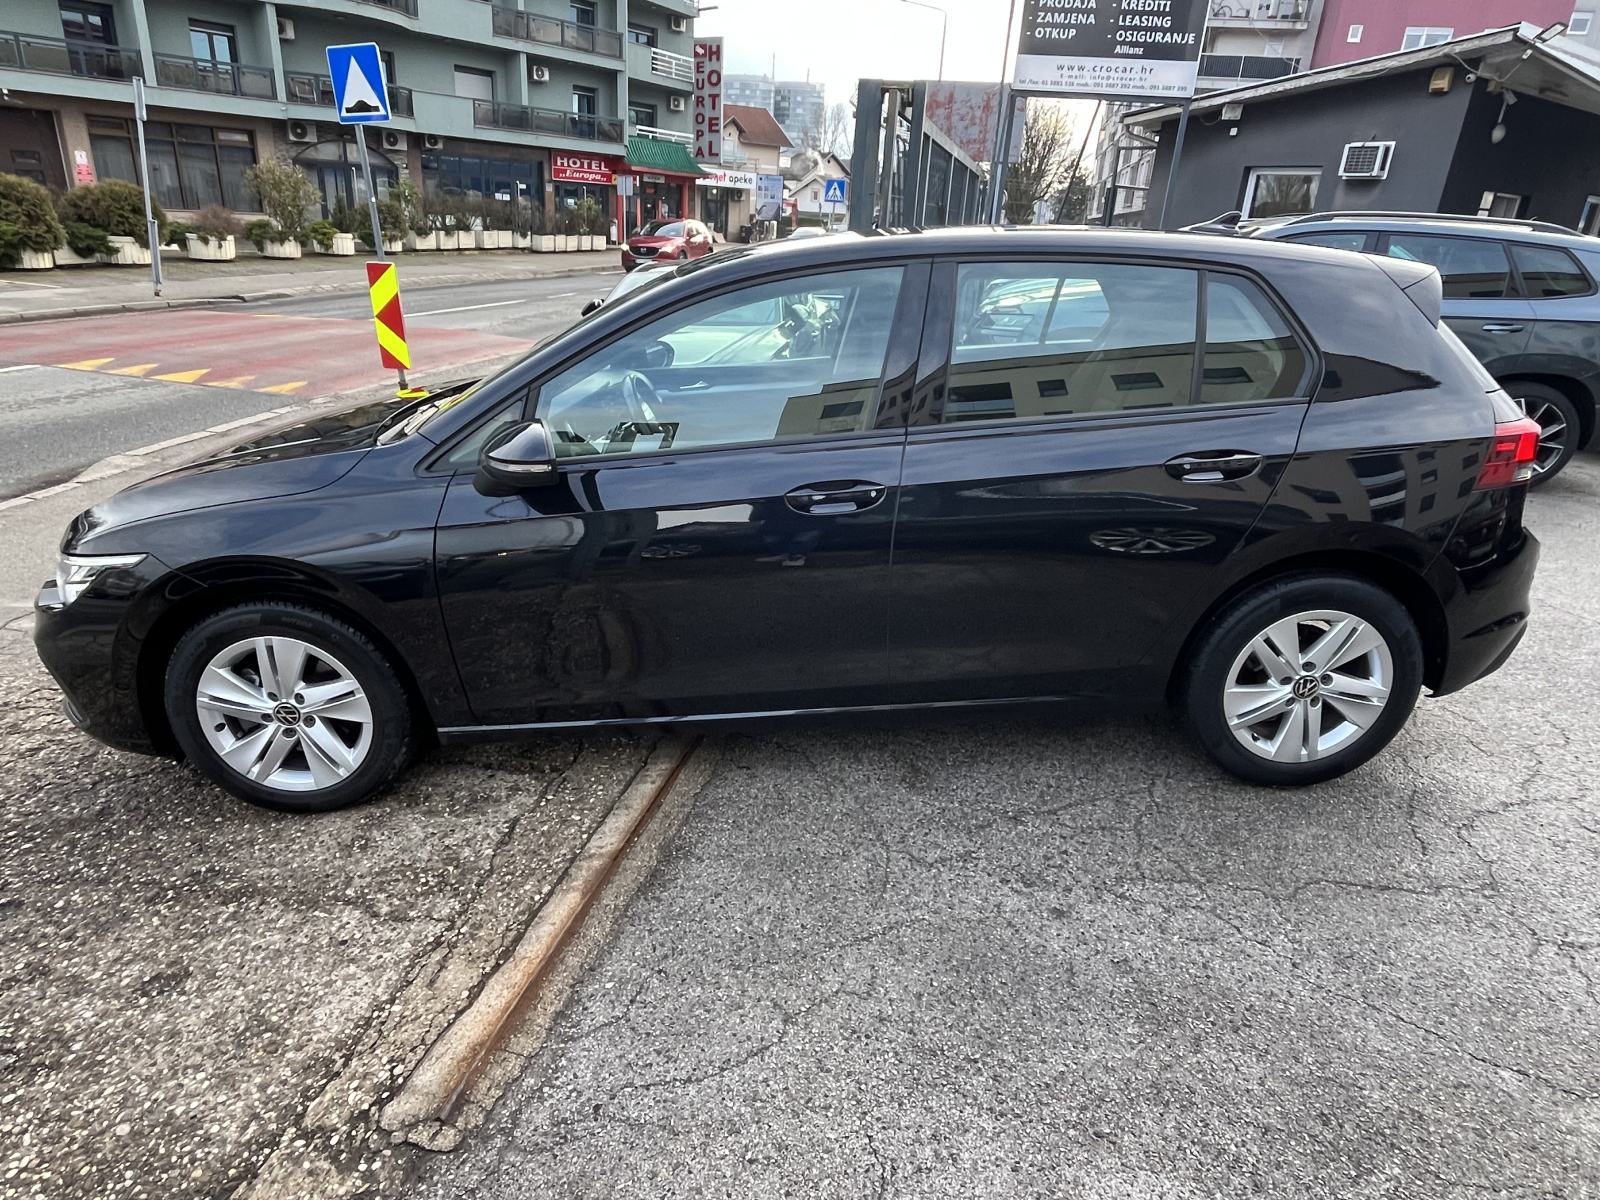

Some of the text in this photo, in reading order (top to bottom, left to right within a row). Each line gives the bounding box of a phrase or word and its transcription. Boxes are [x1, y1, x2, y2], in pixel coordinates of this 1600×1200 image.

[1039, 0, 1097, 9] PRODAJA
[1121, 0, 1171, 12] KREDITI
[1036, 12, 1096, 25] ZAMJENA
[1118, 15, 1172, 28] LEASING
[1034, 27, 1077, 40] OTKUP
[1116, 30, 1196, 44] OSIGURANJE
[1114, 45, 1144, 55] Allianz
[1056, 64, 1154, 75] www.crocar.hr
[707, 44, 721, 157] HOTEL
[695, 61, 705, 158] EUROPA
[556, 156, 609, 171] HOTEL
[728, 174, 753, 185] opeke
